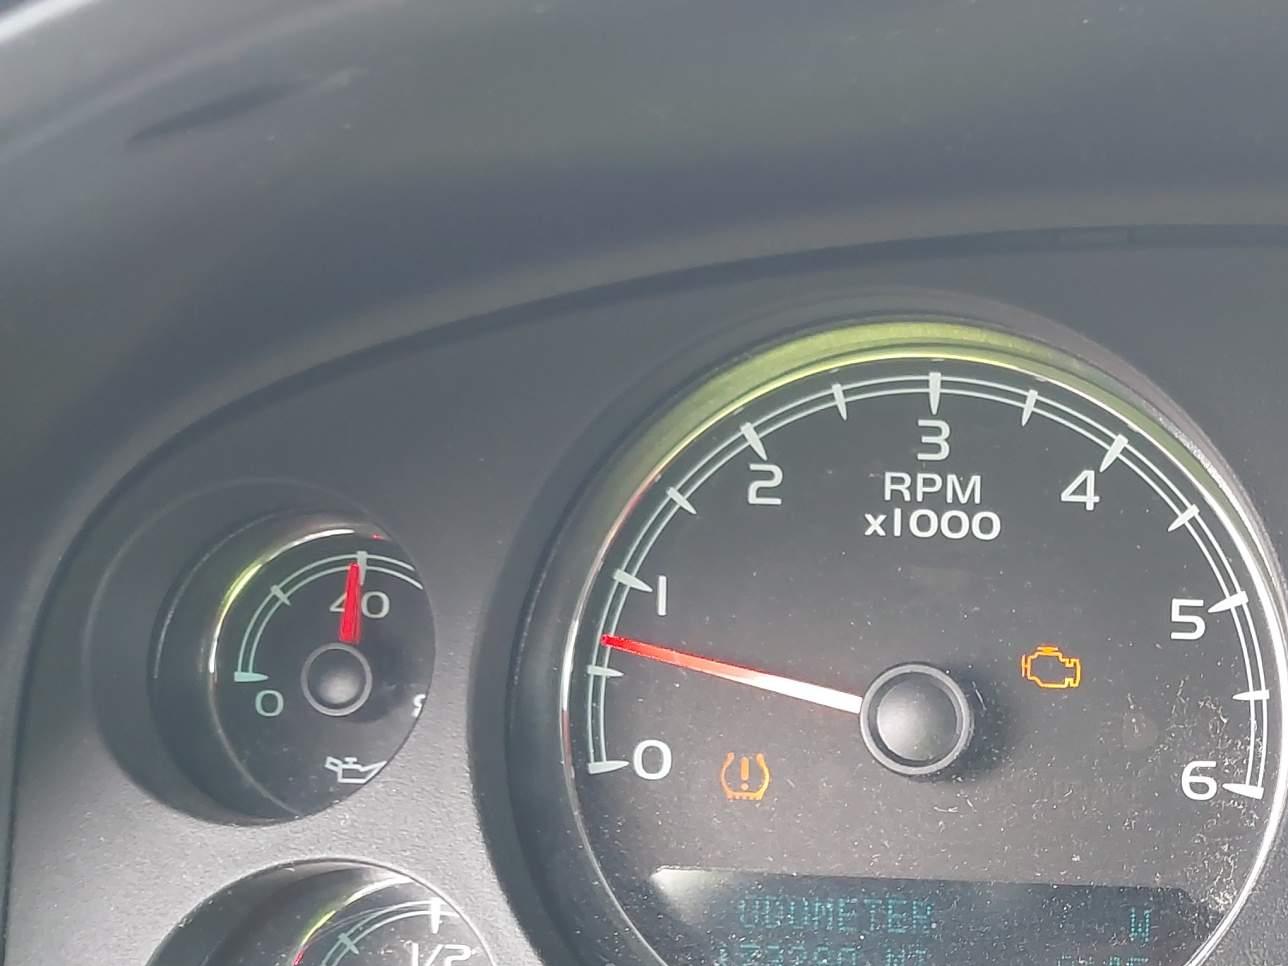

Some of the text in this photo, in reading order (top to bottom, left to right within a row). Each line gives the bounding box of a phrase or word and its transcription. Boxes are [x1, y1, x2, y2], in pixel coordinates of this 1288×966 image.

[915, 419, 951, 461] 3
[747, 463, 783, 506] 2
[883, 471, 983, 504] RPM
[1060, 470, 1101, 512] 4
[864, 509, 1002, 541] x1000
[656, 575, 669, 616] 1
[1170, 599, 1206, 642] 5
[254, 689, 285, 717] 0
[632, 739, 672, 780] 0
[1180, 760, 1217, 800] 6
[1128, 907, 1152, 943] W
